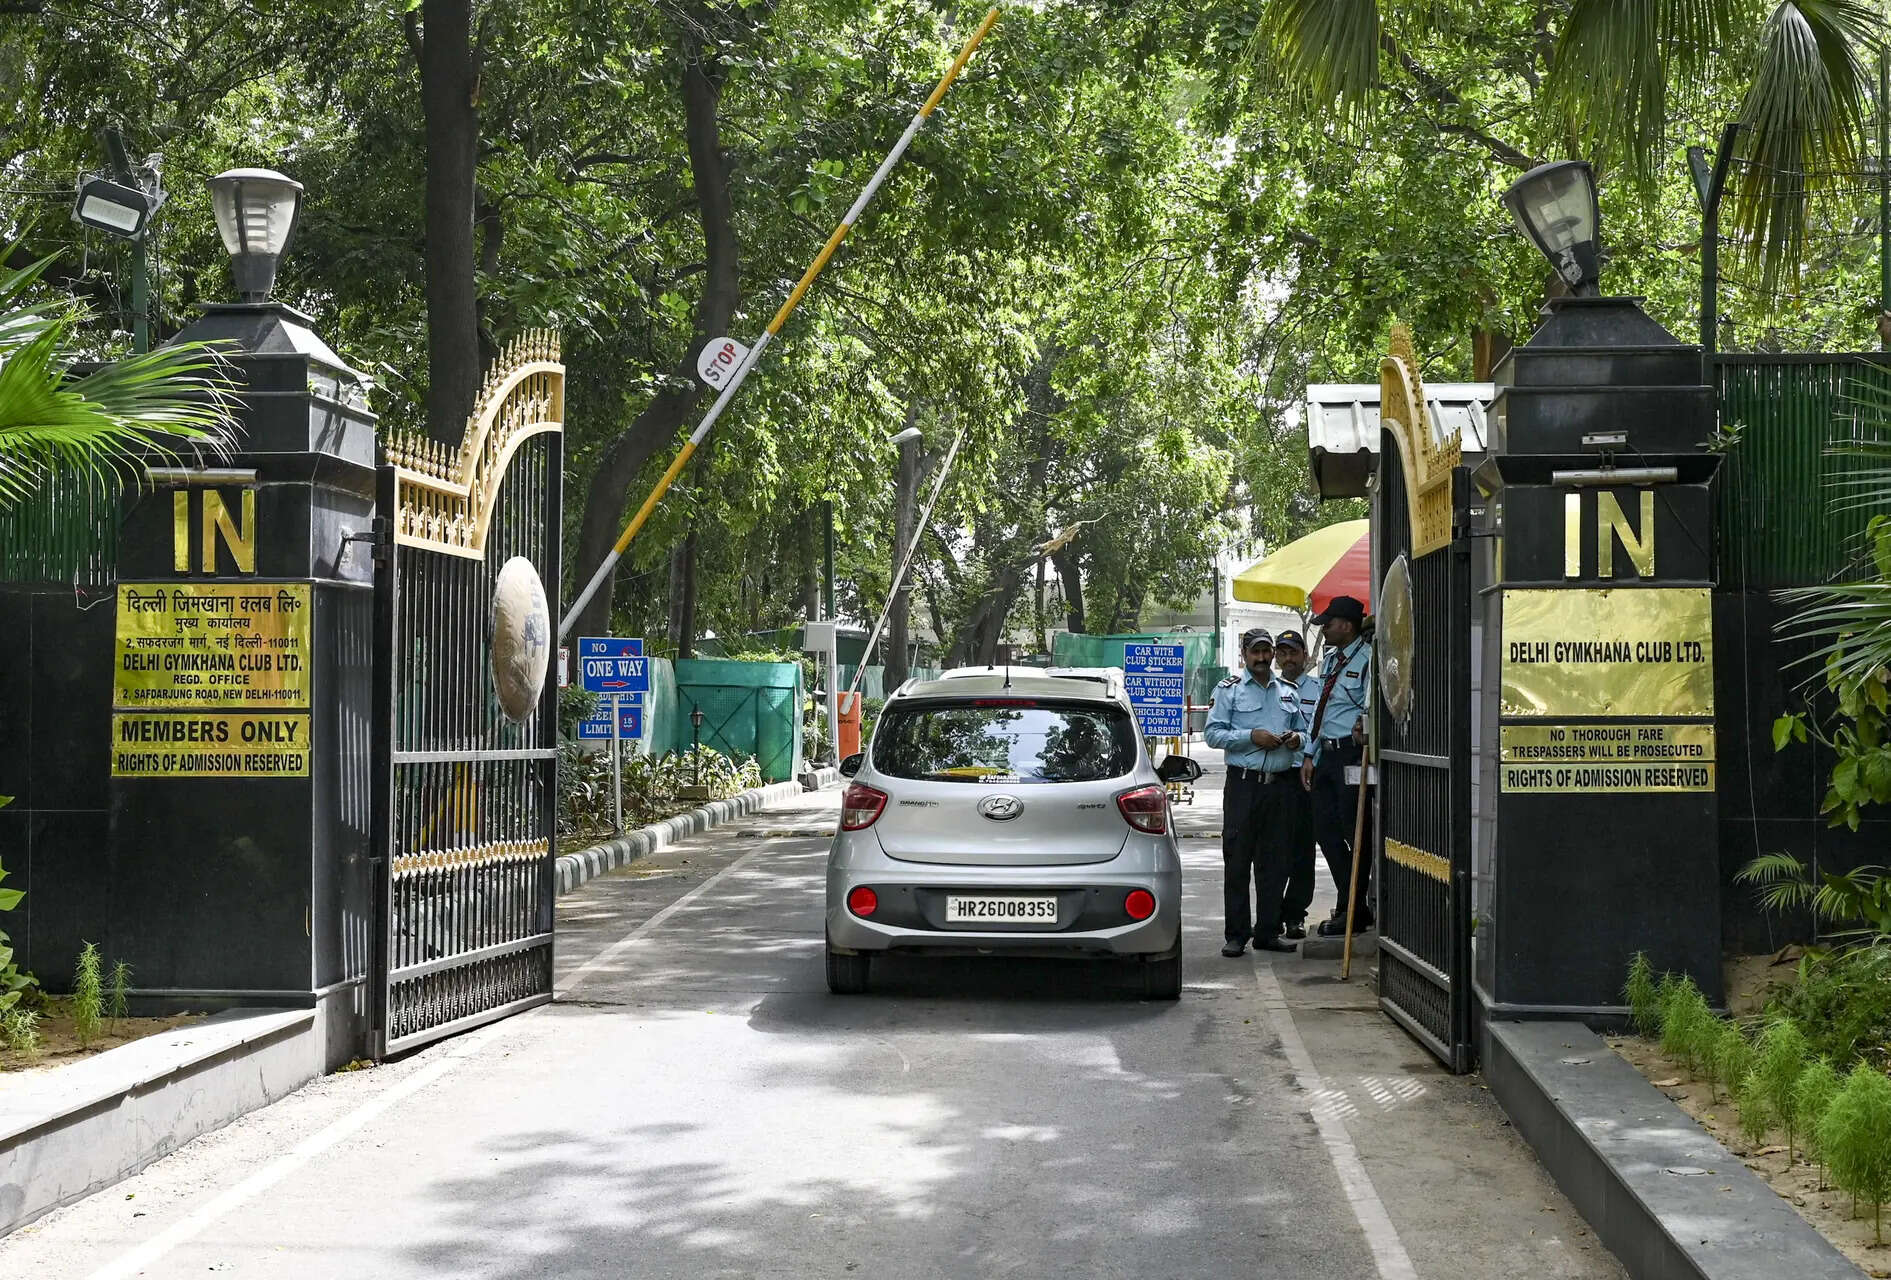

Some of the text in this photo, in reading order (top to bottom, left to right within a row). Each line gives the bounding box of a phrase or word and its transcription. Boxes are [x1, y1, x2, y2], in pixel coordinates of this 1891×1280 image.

[705, 343, 736, 381] STOP
[174, 489, 256, 573] IN
[1564, 490, 1654, 577] IN
[126, 589, 167, 613] दिल्ली
[172, 589, 235, 613] जिमखाना
[240, 596, 272, 613] क्लब
[175, 614, 251, 633] मुख्य कार्यालय
[188, 633, 211, 650] मार्ग,
[215, 634, 229, 649] नई
[592, 643, 607, 653] NO
[1135, 647, 1174, 656] CAR WITH
[1510, 642, 1705, 663] DELHI GYMKHANA CLUB LTD.
[123, 654, 302, 672] DELHI GYMKHANA CLUB LTD.
[587, 660, 644, 677] ONE WAY
[1125, 656, 1183, 666] CLUB STICKER
[173, 674, 250, 685] REGD. OFFICE
[1125, 677, 1182, 687] CAR WITHOUT
[134, 689, 192, 699] SAFDARJUNG
[195, 689, 221, 700] ROAD,
[223, 689, 242, 699] NEW
[245, 689, 301, 699] DELHI-110011
[1126, 687, 1182, 697] CLUB STICKER
[121, 721, 299, 742] MEMBERS ONLY
[1148, 726, 1180, 734] BARRIER
[1550, 729, 1664, 741] NO THOROUGH FARE
[1512, 745, 1703, 757] TRESPASSERS WILL BE PROSECUTED
[118, 754, 303, 772] RIGHTS OF ADMISSION RESERVED
[1508, 768, 1709, 788] RIGHTS OF ADMISSION RESERVED
